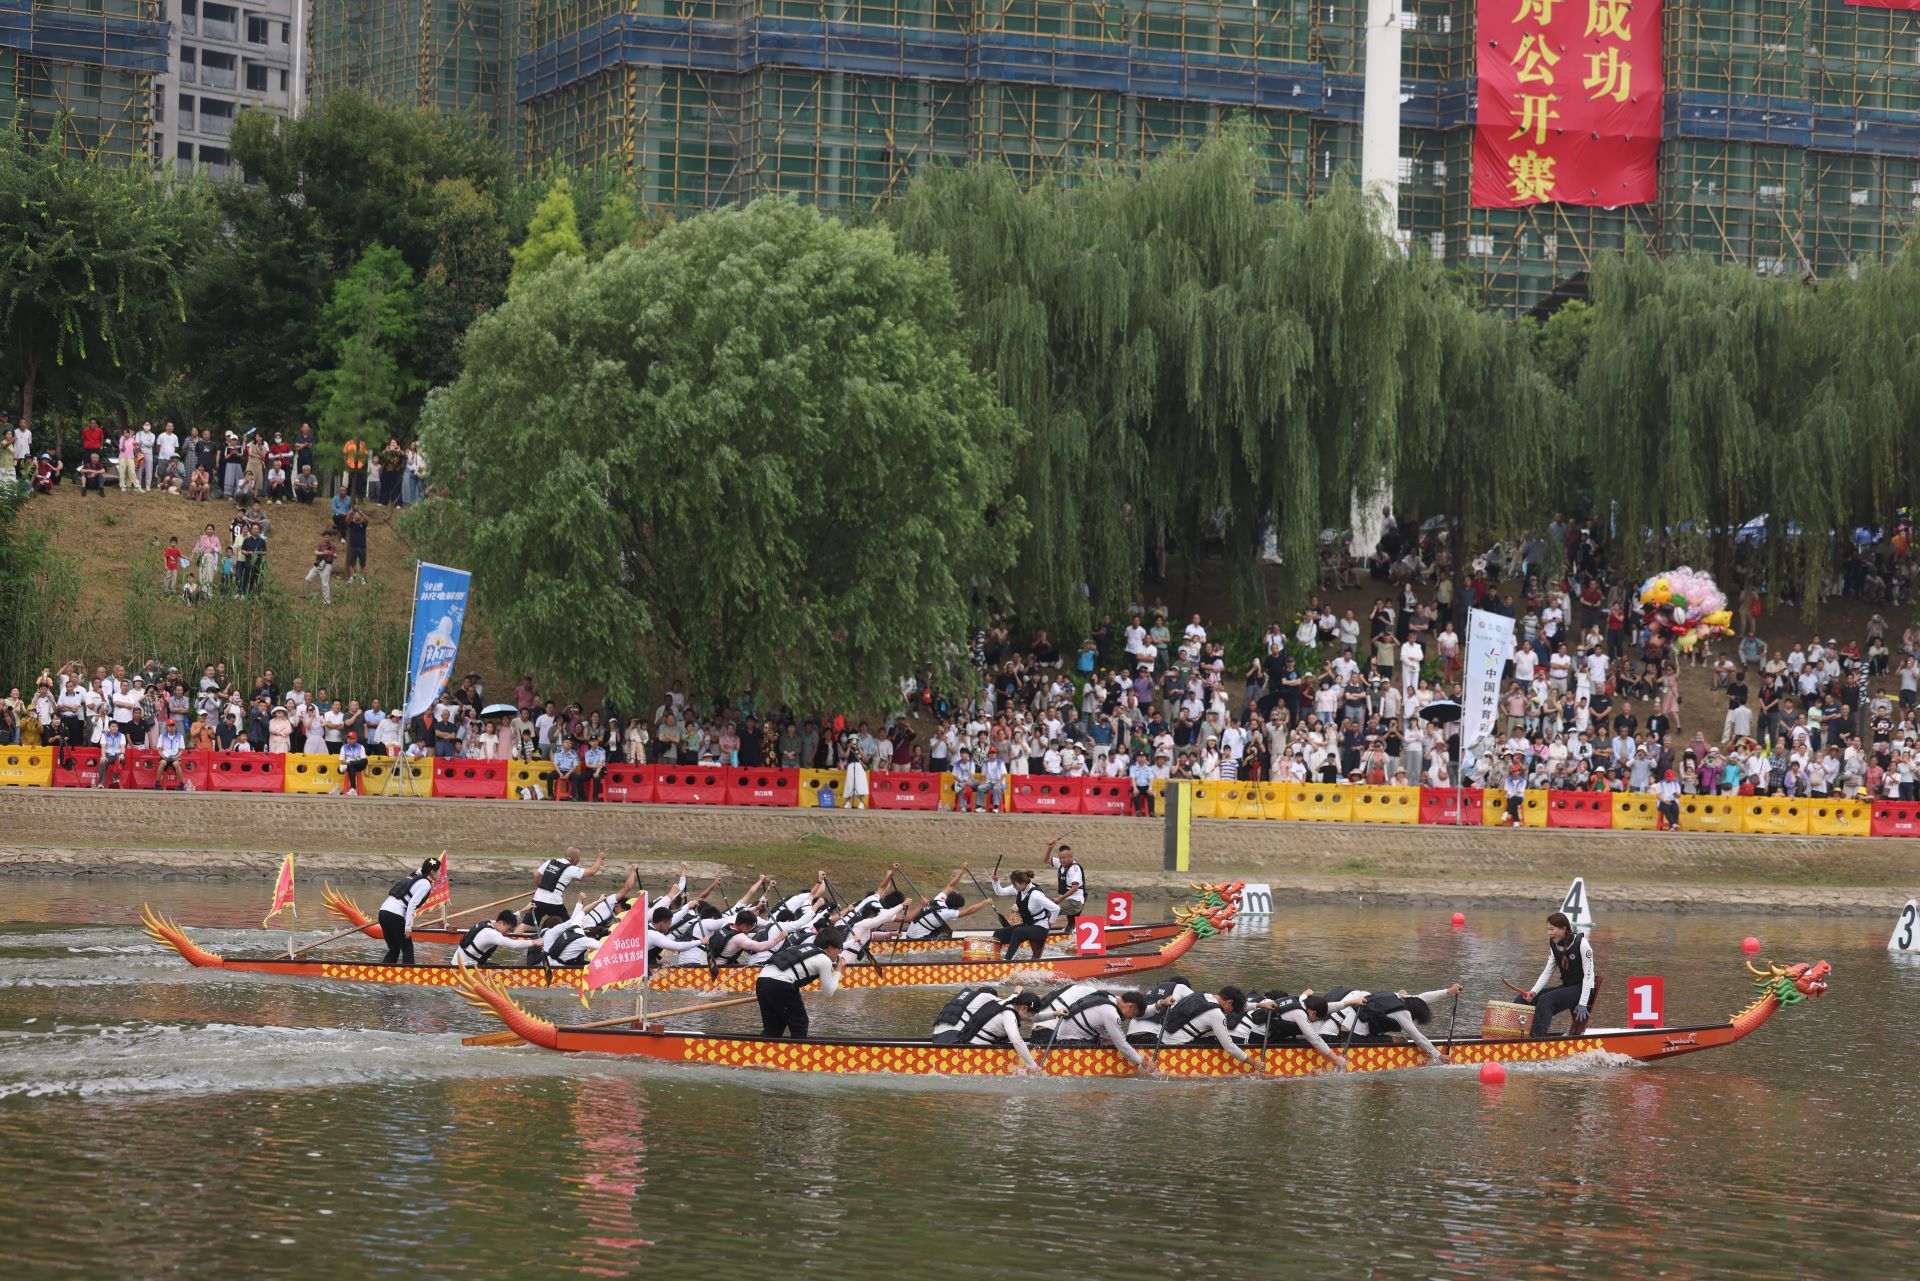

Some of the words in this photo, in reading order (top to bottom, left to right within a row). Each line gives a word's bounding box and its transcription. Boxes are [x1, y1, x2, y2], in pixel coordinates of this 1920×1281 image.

[1583, 0, 1632, 102] 成功
[1109, 897, 1127, 921] 3
[1563, 882, 1582, 922] 4
[1079, 922, 1102, 950] 2
[1898, 905, 1915, 950] 3
[1632, 984, 1659, 1021] 1
